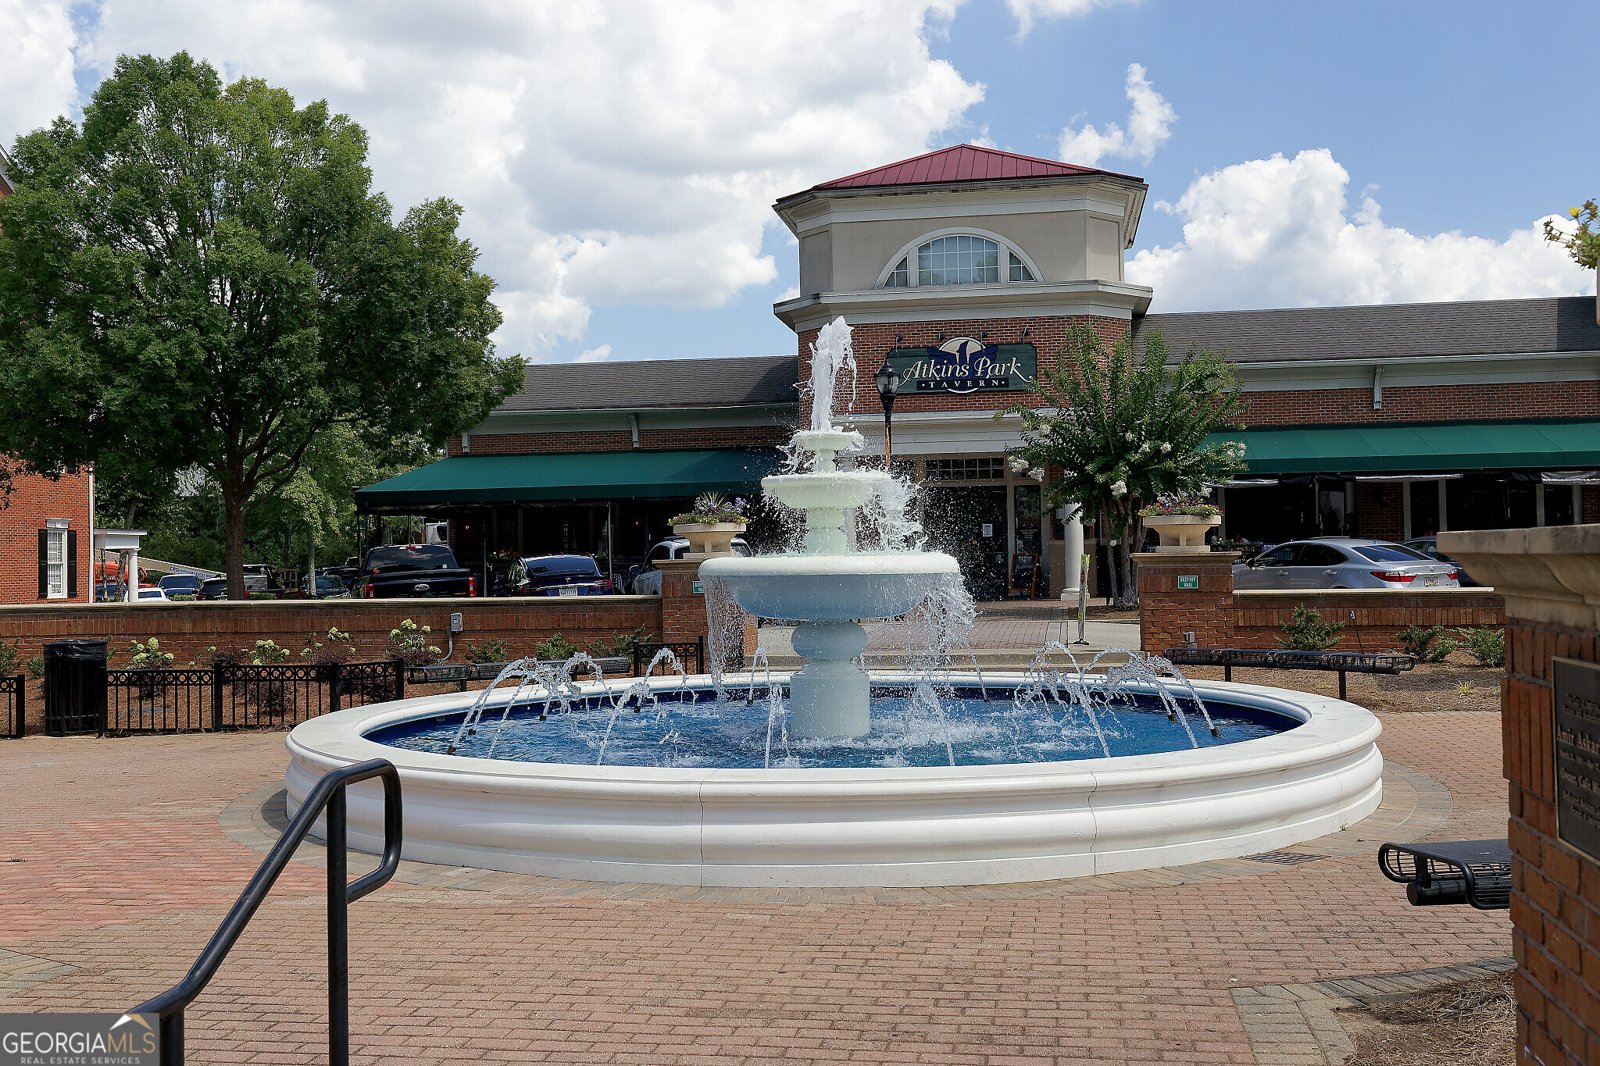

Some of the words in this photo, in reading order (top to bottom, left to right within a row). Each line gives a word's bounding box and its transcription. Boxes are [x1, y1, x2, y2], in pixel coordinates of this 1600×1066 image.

[899, 359, 970, 385] Atkins
[974, 356, 1033, 383] Park
[928, 379, 999, 388] TAVERN
[1557, 724, 1575, 746] Amir
